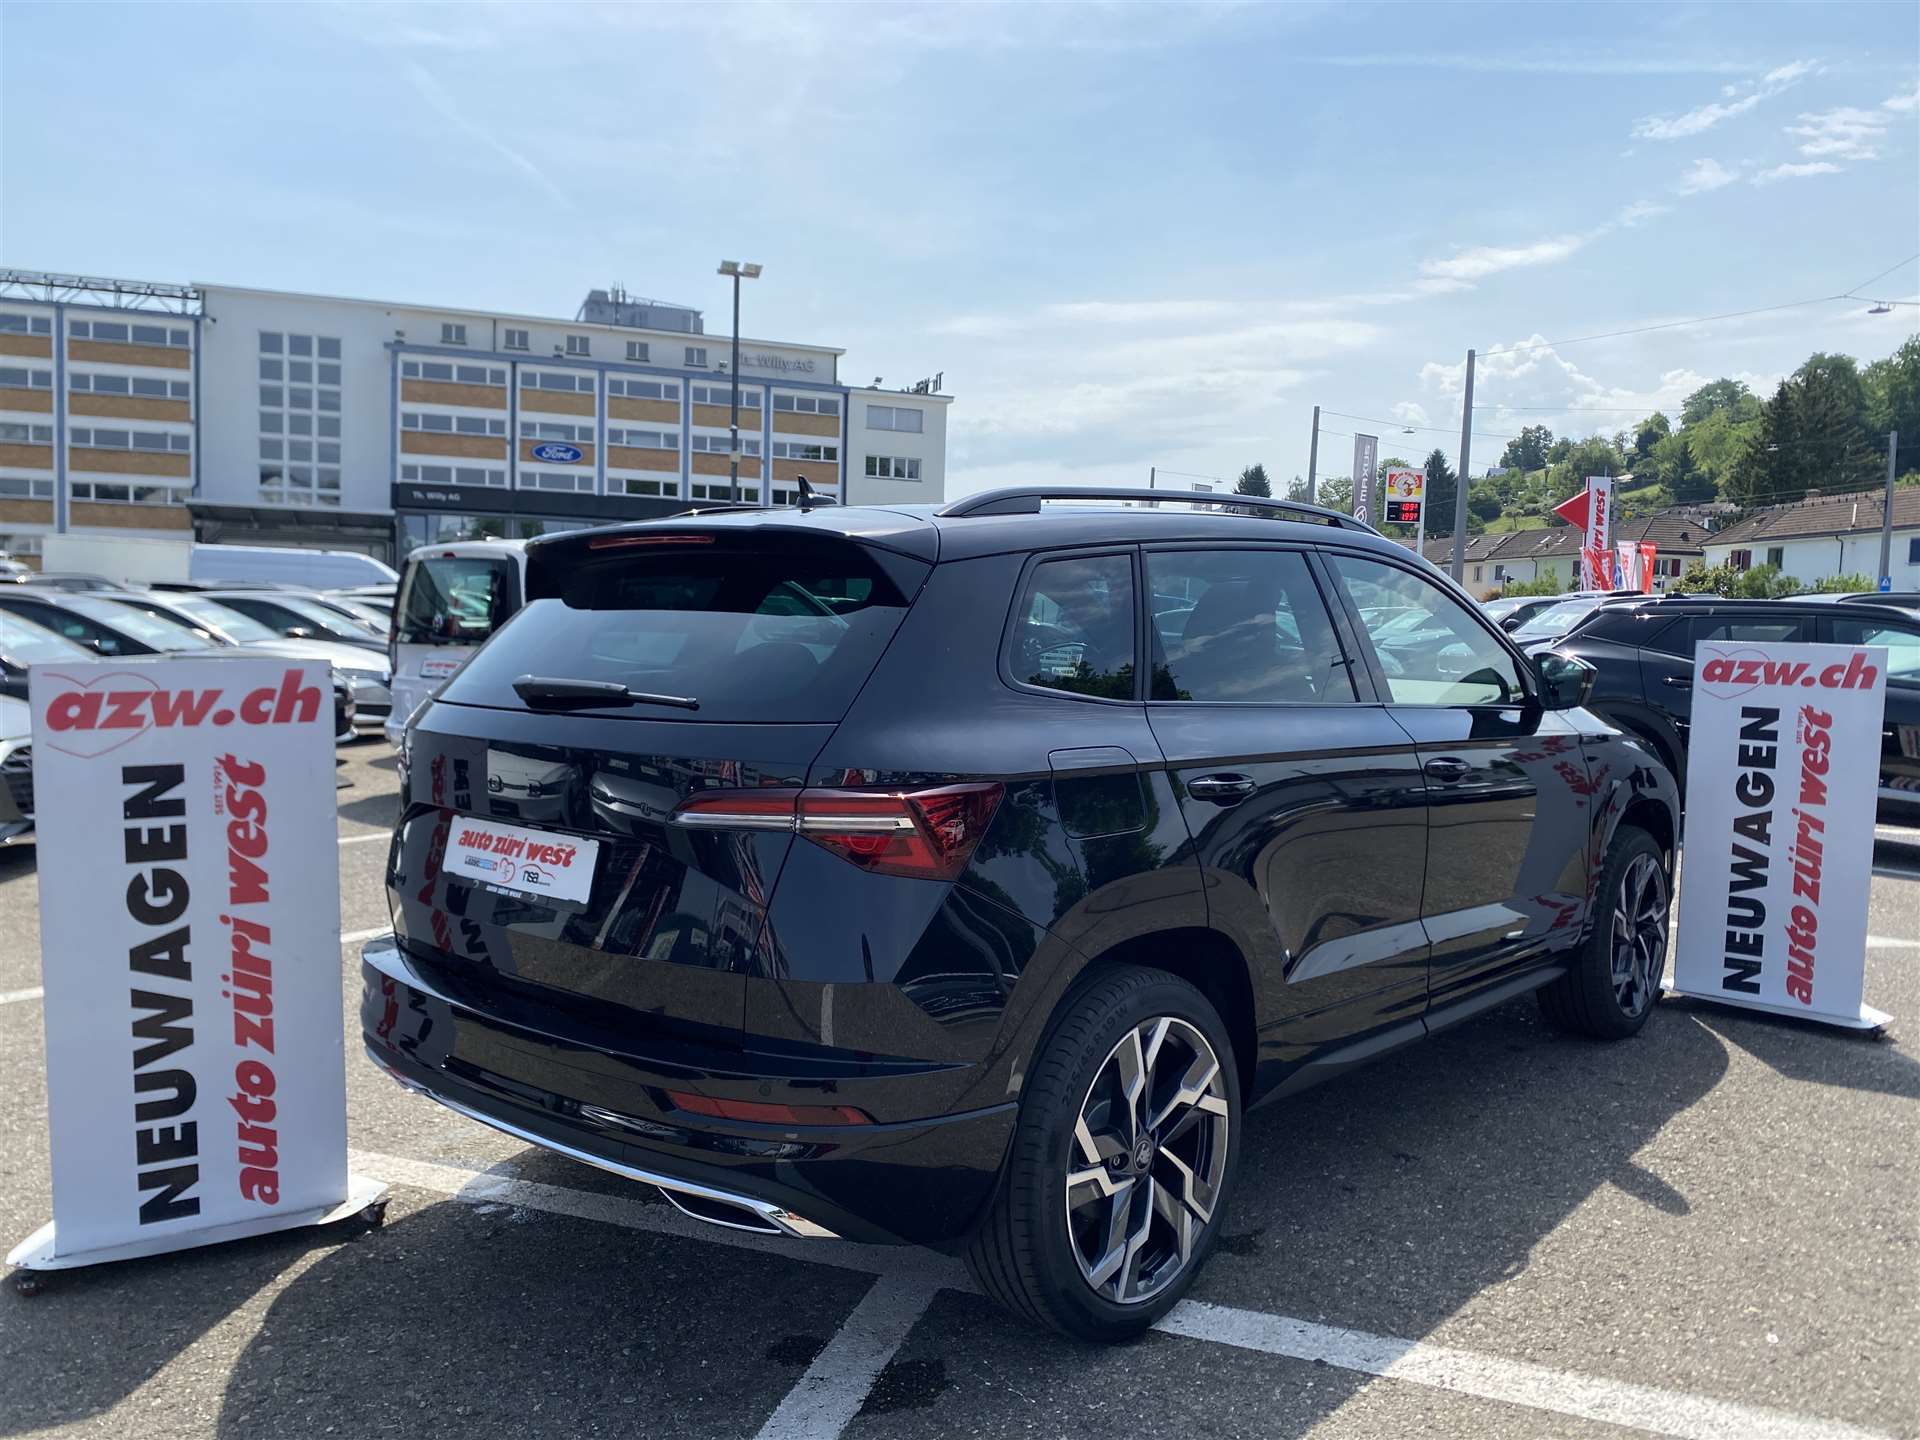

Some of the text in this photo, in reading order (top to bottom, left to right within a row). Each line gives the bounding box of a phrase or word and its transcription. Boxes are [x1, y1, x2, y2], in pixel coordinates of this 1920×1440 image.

[542, 446, 574, 460] Ford
[1359, 444, 1371, 502] MAXUS
[426, 491, 446, 501] Willy
[448, 492, 461, 501] AG
[1595, 488, 1607, 527] west
[1702, 652, 1879, 691] azw.ch
[46, 669, 322, 732] azw.ch
[214, 793, 224, 816] SEIT
[458, 829, 494, 851] auto
[492, 833, 529, 858] züri
[526, 842, 577, 868] west
[1722, 705, 1781, 995] NEUWAGEN
[1784, 703, 1833, 1006] auto züri west
[523, 870, 539, 884] nsa
[121, 763, 201, 1226] NEUWAGEN
[215, 753, 280, 1206] auto züri west
